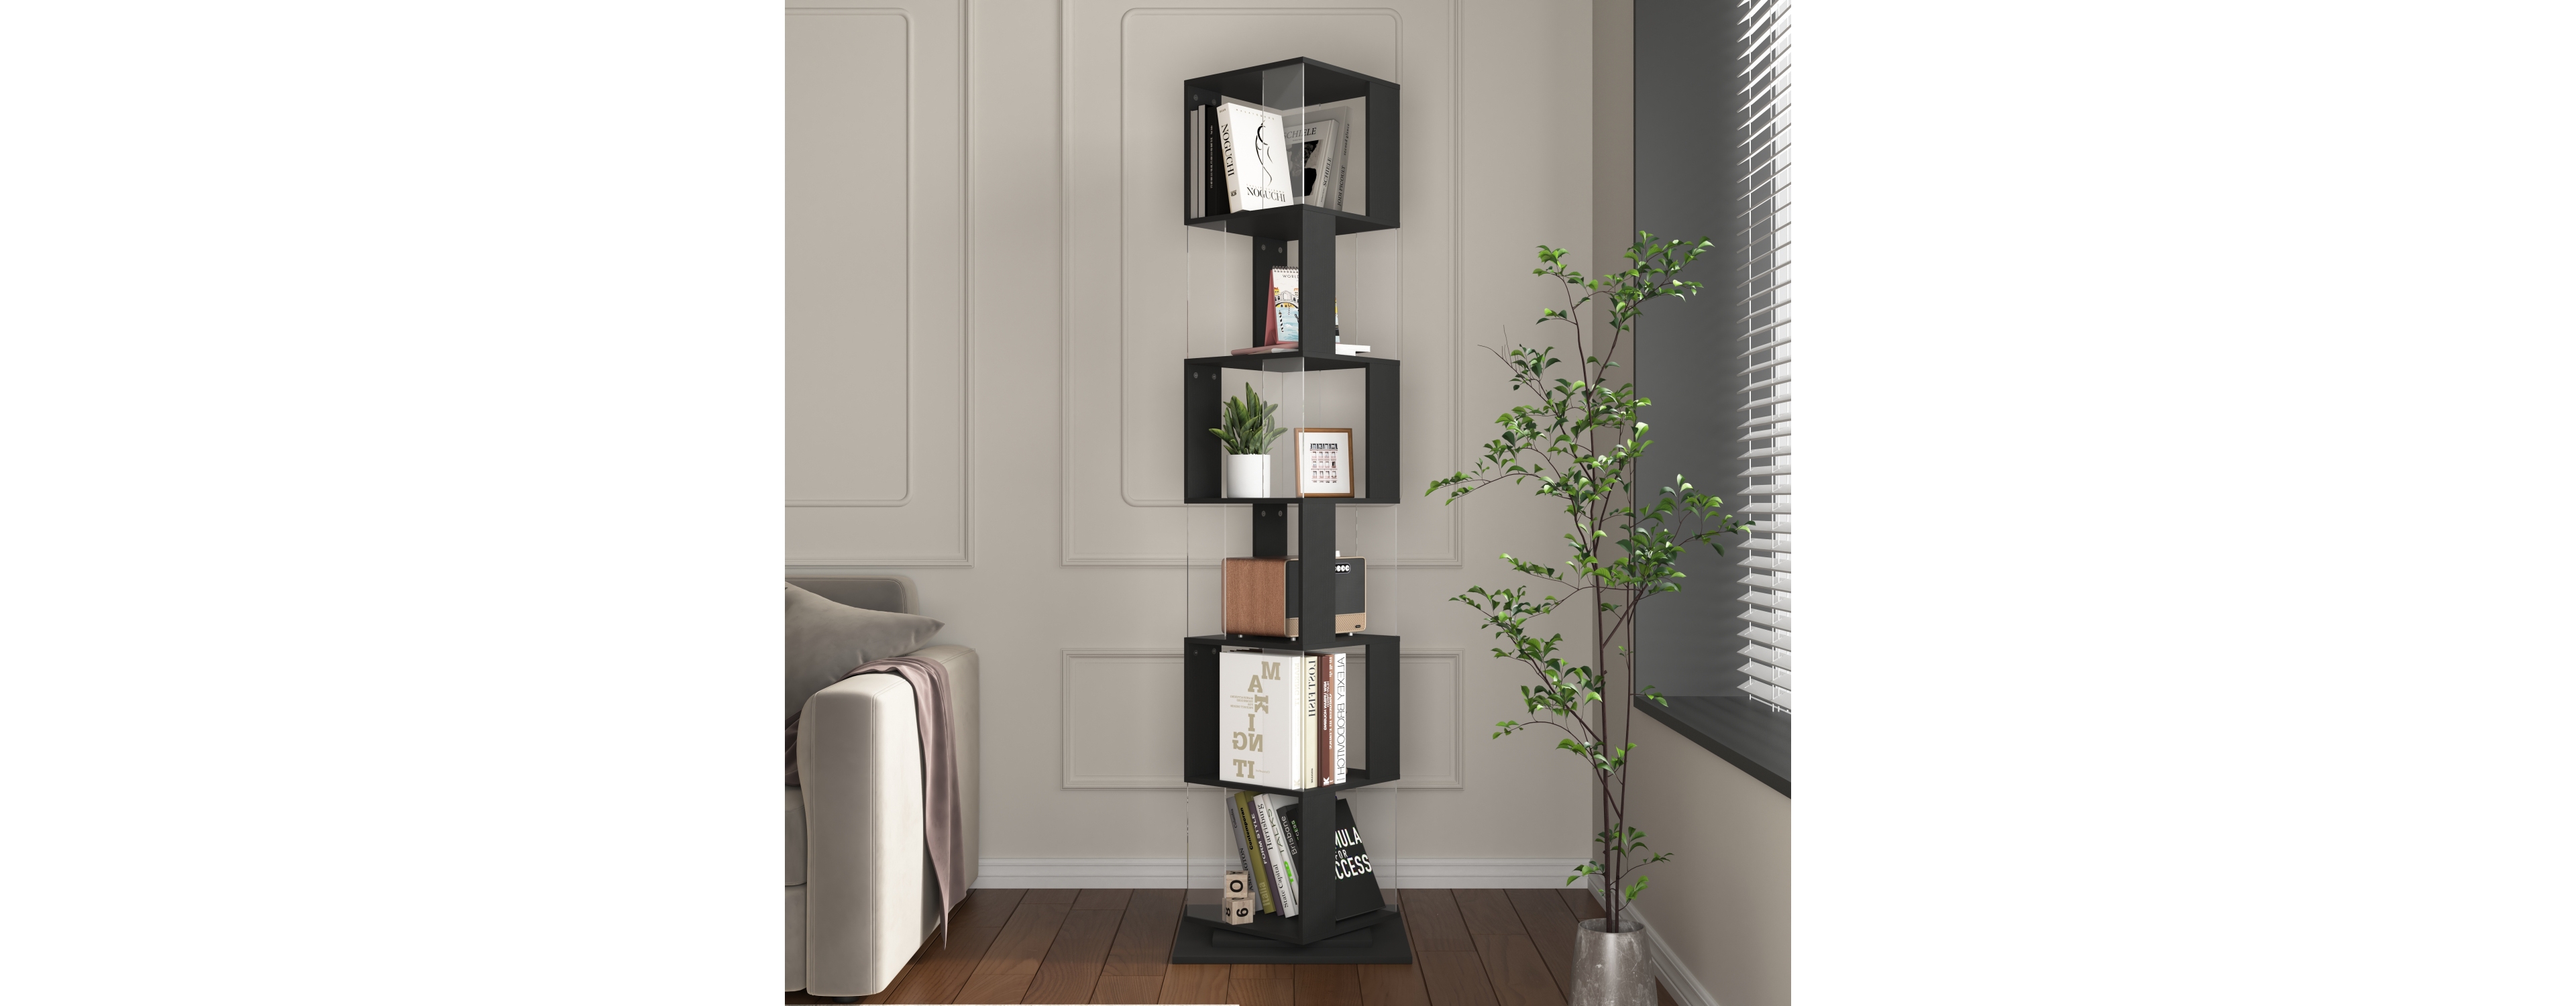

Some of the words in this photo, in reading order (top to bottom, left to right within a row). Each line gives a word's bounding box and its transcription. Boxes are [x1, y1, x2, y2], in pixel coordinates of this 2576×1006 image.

[1221, 123, 1235, 176] NOGUCHI
[1322, 157, 1332, 187] SCHIELE
[1246, 186, 1286, 203] NOGUCHI
[1240, 807, 1254, 850] Contemporan
[1250, 813, 1260, 839] STYLE
[1257, 803, 1273, 850] Harrisburg
[1267, 808, 1285, 853] TALKS
[1281, 816, 1297, 855] Brisbane
[1291, 820, 1299, 840] CESS
[1258, 840, 1268, 864] FORM
[1273, 864, 1283, 889] Capital
[1335, 854, 1373, 880] CCESS
[1258, 881, 1271, 907] Italia
